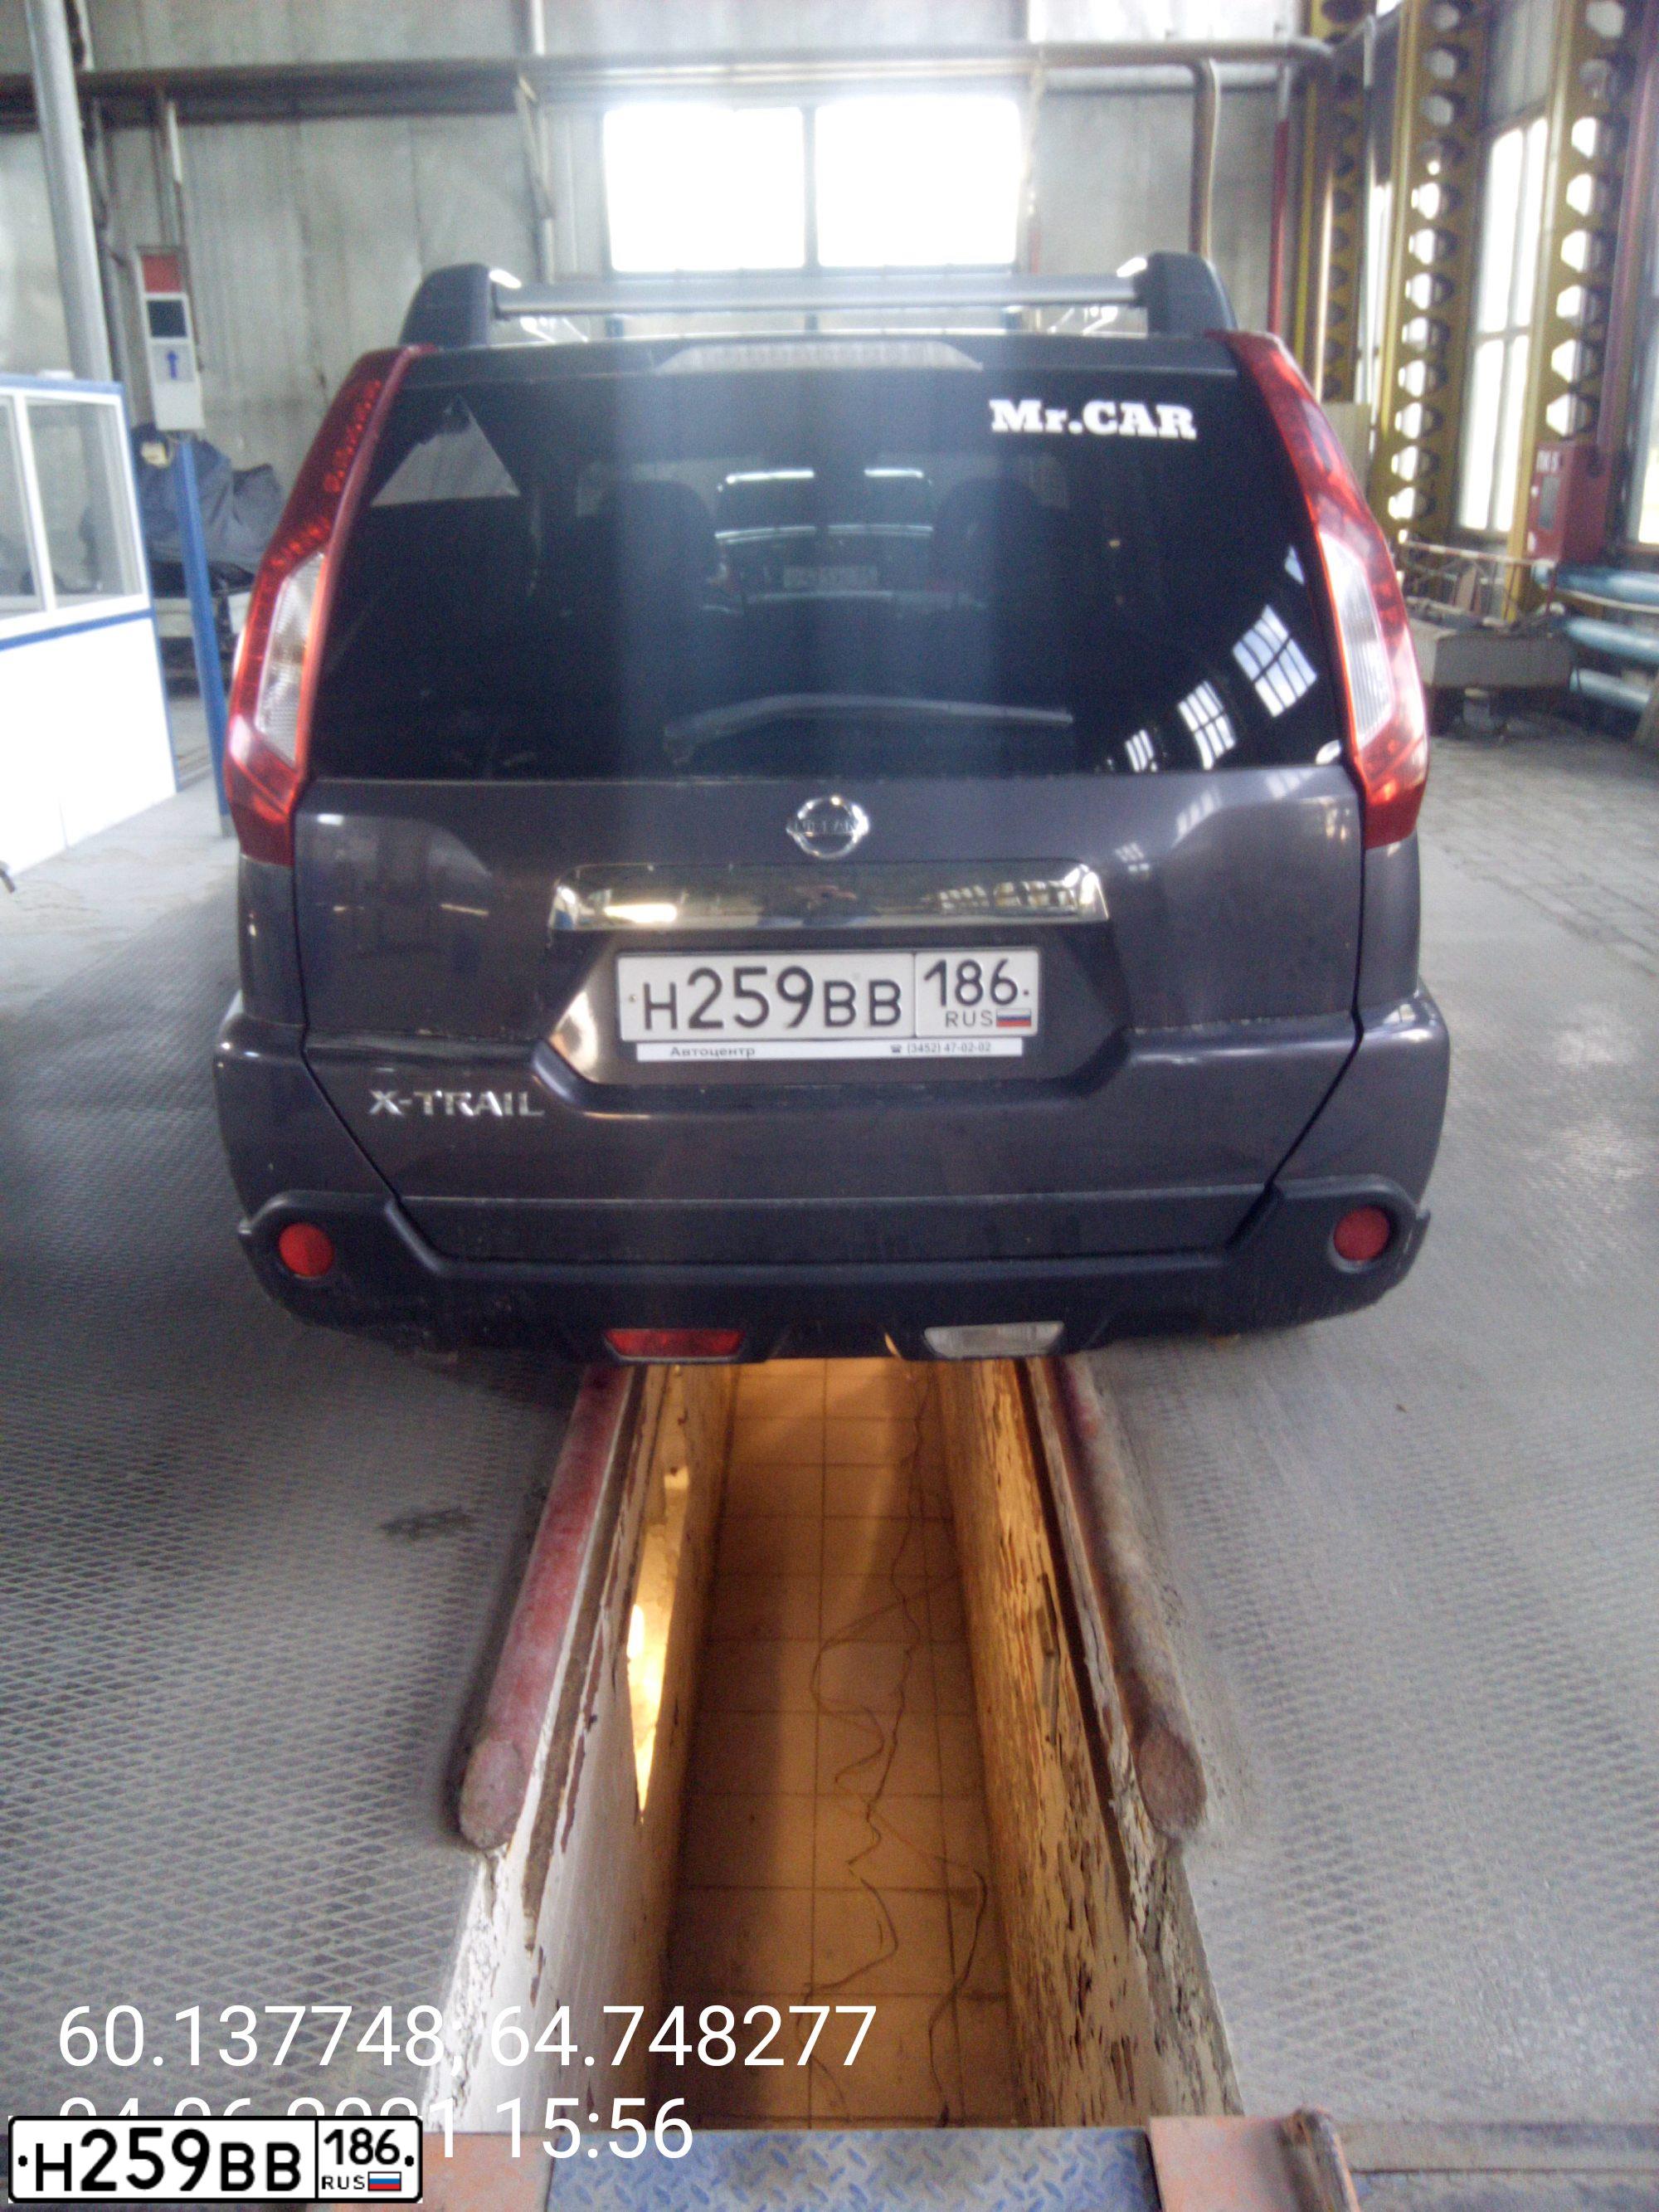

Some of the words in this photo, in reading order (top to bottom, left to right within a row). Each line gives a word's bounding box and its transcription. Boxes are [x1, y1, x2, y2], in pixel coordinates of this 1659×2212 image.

[990, 399, 1197, 440] Mr.CAR
[923, 958, 1019, 1006] 186
[944, 1011, 994, 1027] RUS
[669, 1046, 756, 1058] Автоцентр
[907, 1042, 941, 1055] (3452)
[369, 1089, 545, 1116] X-TRAIL
